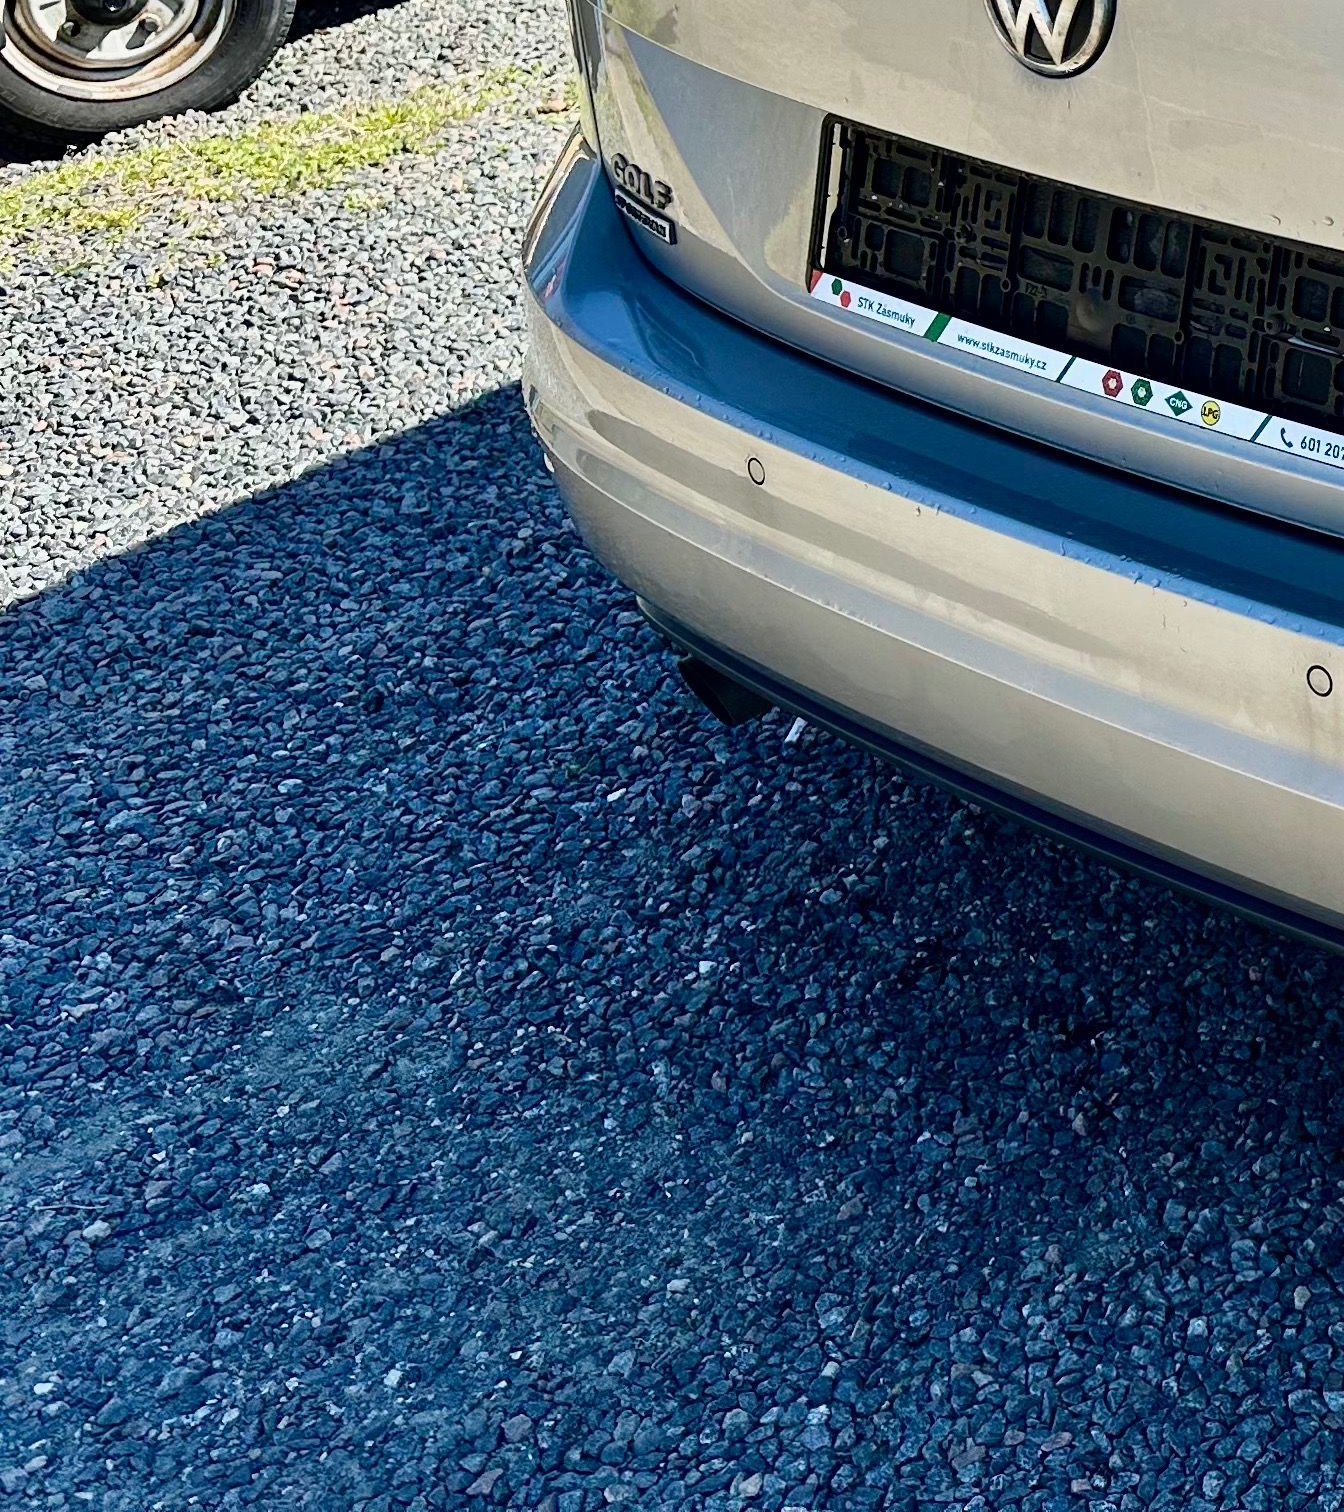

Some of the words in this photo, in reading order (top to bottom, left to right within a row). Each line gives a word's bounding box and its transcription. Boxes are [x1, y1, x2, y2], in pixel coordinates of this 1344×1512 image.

[611, 153, 674, 210] GOLF
[857, 296, 874, 311] STK
[957, 333, 1047, 371] www.stkzasmuky.cz
[1169, 396, 1188, 410] CNG
[1201, 406, 1219, 421] LPG
[1300, 435, 1321, 453] 601
